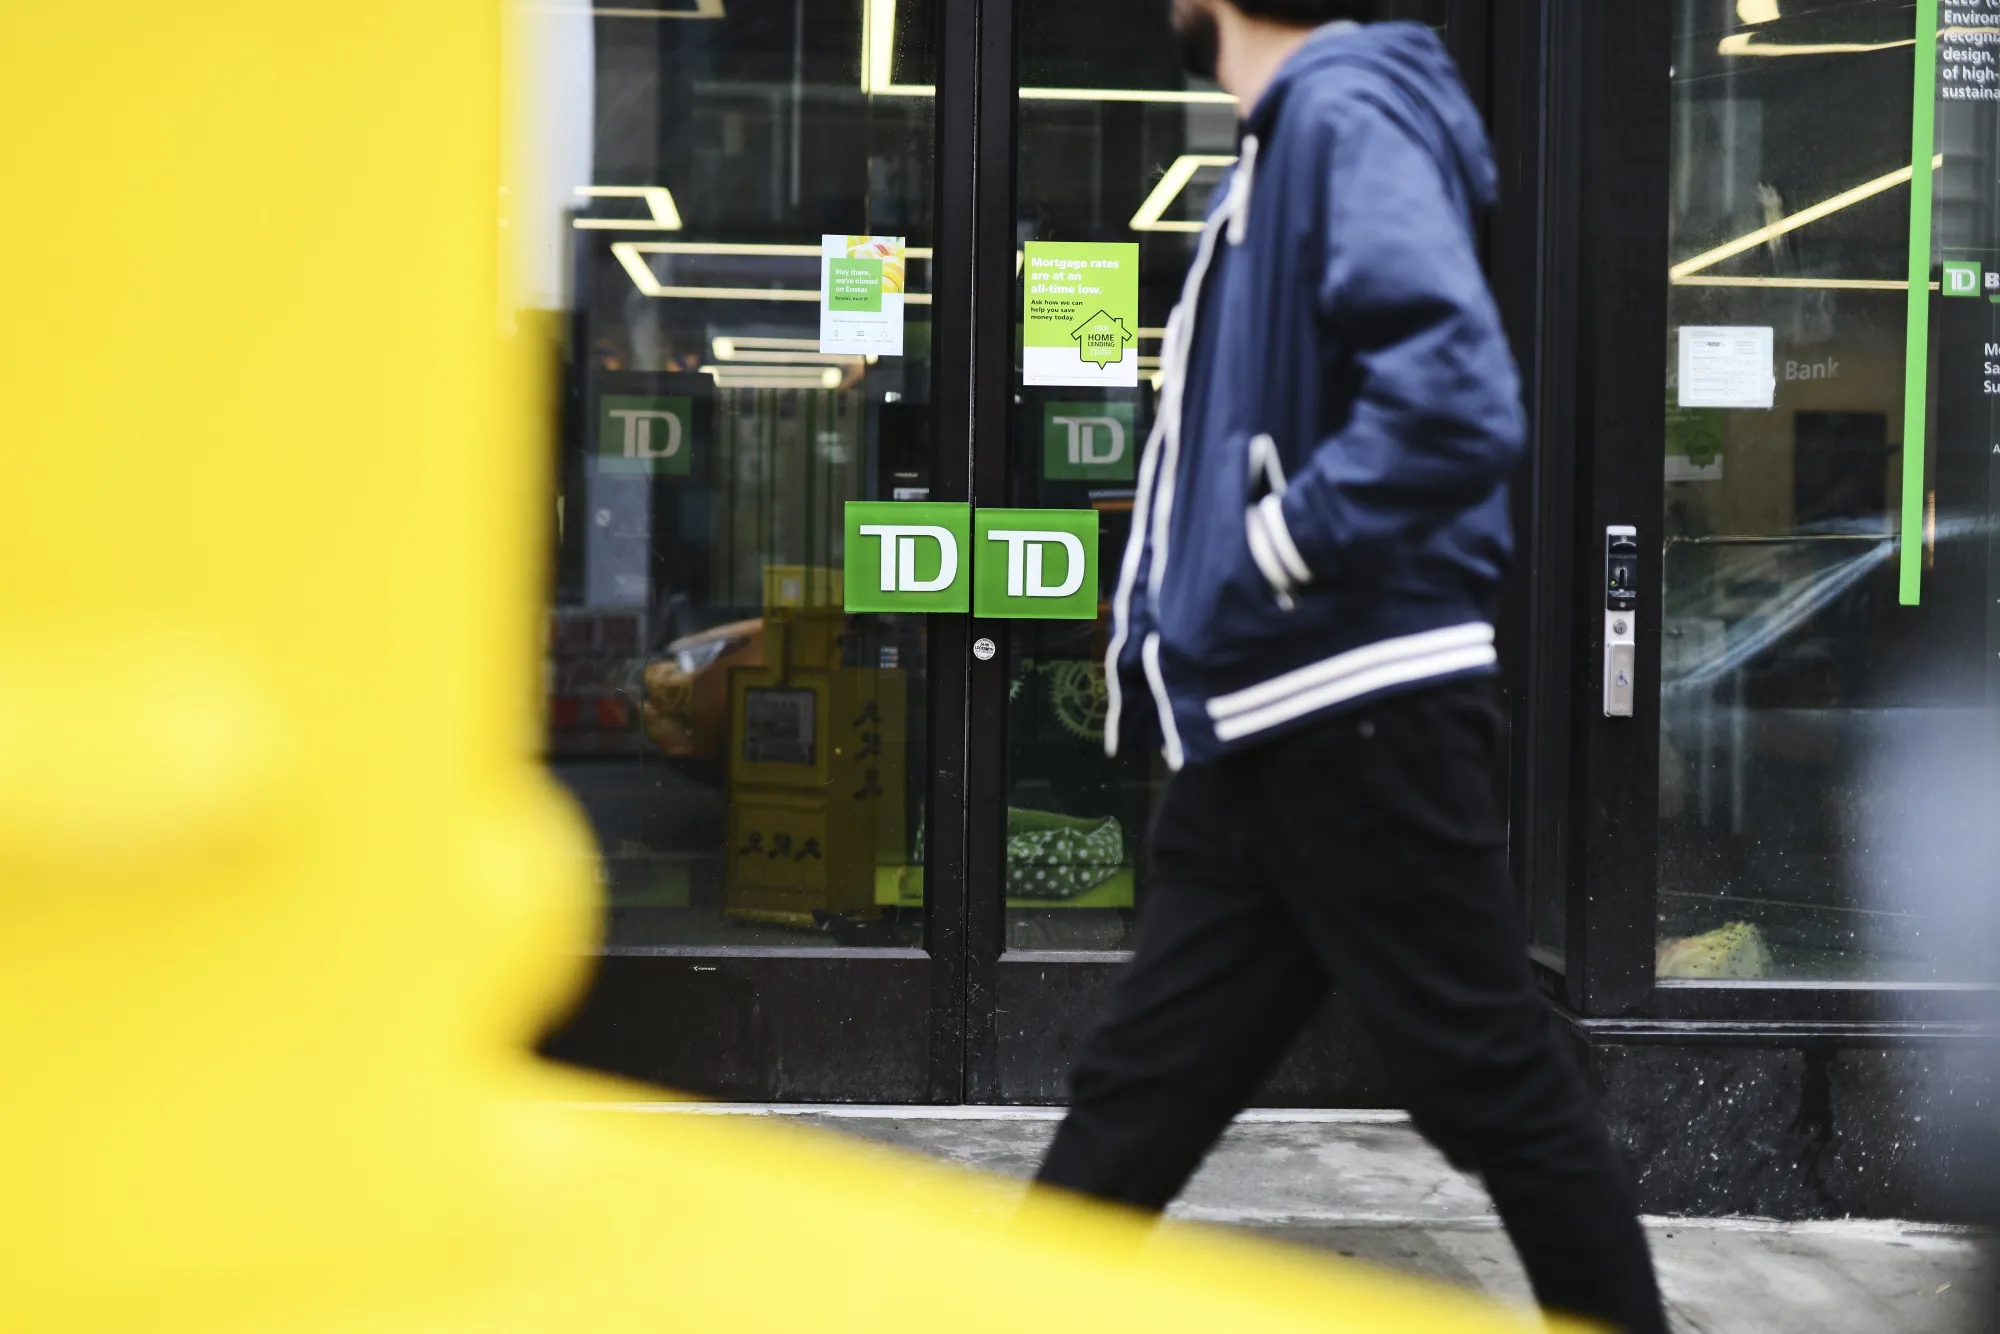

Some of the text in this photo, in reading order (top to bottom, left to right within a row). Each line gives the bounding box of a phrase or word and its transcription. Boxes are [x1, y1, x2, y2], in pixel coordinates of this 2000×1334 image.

[1943, 46, 1995, 65] design,
[1943, 65, 1999, 83] of high-
[1943, 86, 2000, 98] sustaina
[1031, 258, 1119, 269] Mortgage rates
[1031, 271, 1082, 281] are at an
[1945, 268, 1976, 290] TD
[1031, 284, 1101, 294] all-time low.
[1984, 342, 2000, 356] M
[1785, 356, 1840, 380] Bank
[609, 409, 682, 459] TD
[1053, 416, 1125, 464] TD
[859, 524, 958, 593] TD
[987, 529, 1086, 598] TD
